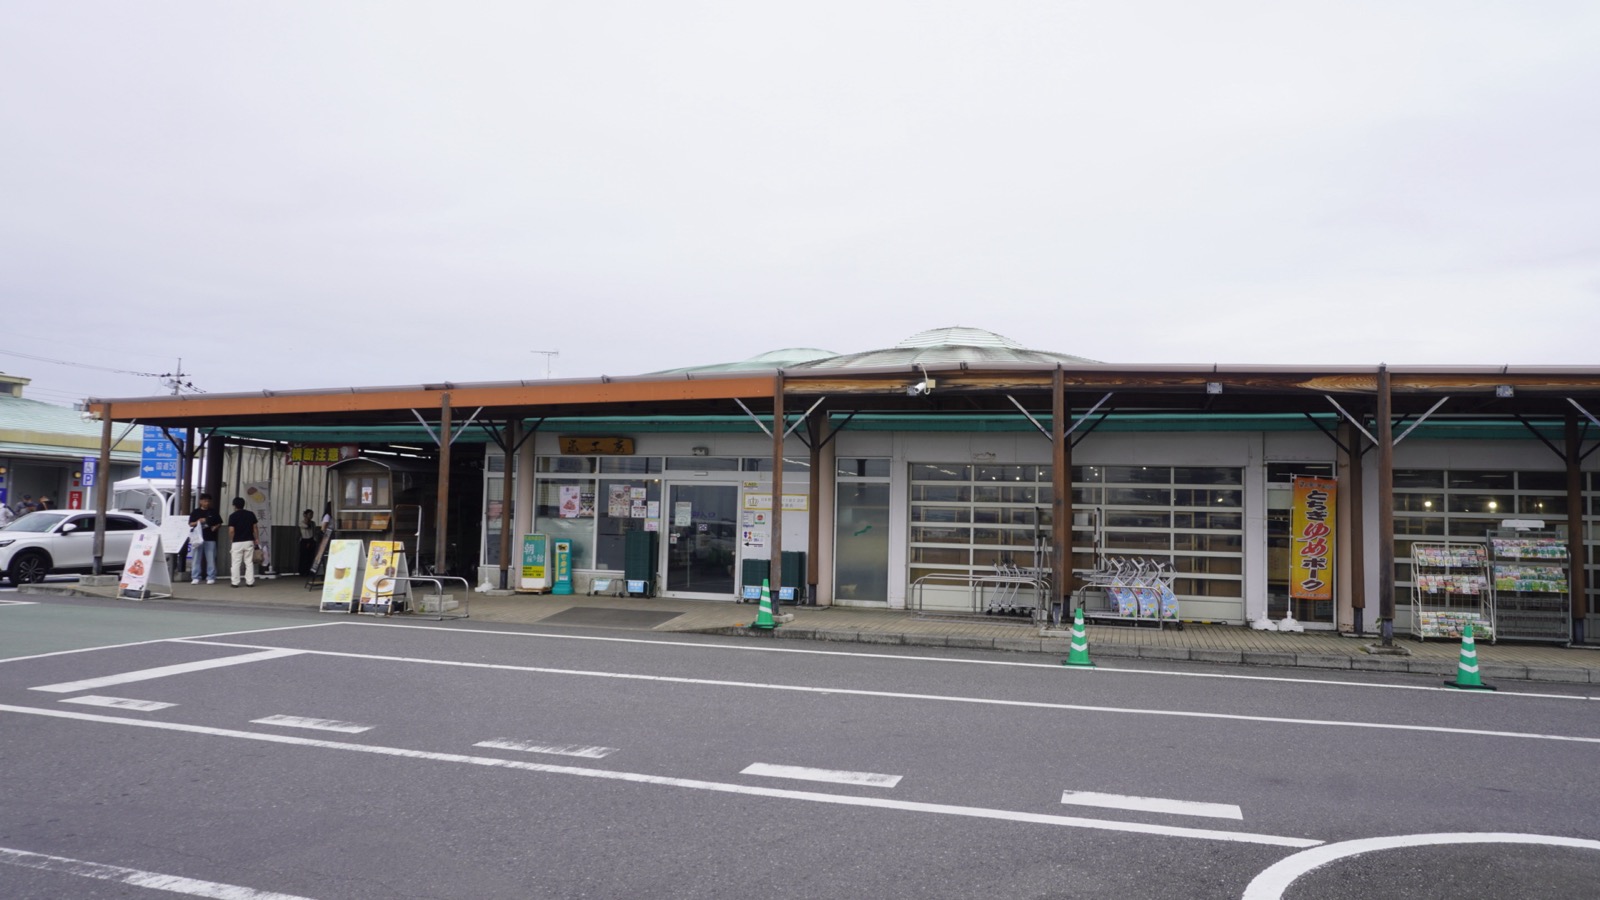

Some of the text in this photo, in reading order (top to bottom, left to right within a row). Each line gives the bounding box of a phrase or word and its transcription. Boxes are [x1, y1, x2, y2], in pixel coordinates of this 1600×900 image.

[292, 447, 339, 461] 横断注意
[85, 474, 91, 484] P
[1297, 489, 1330, 591] とちぎゆめポーク
